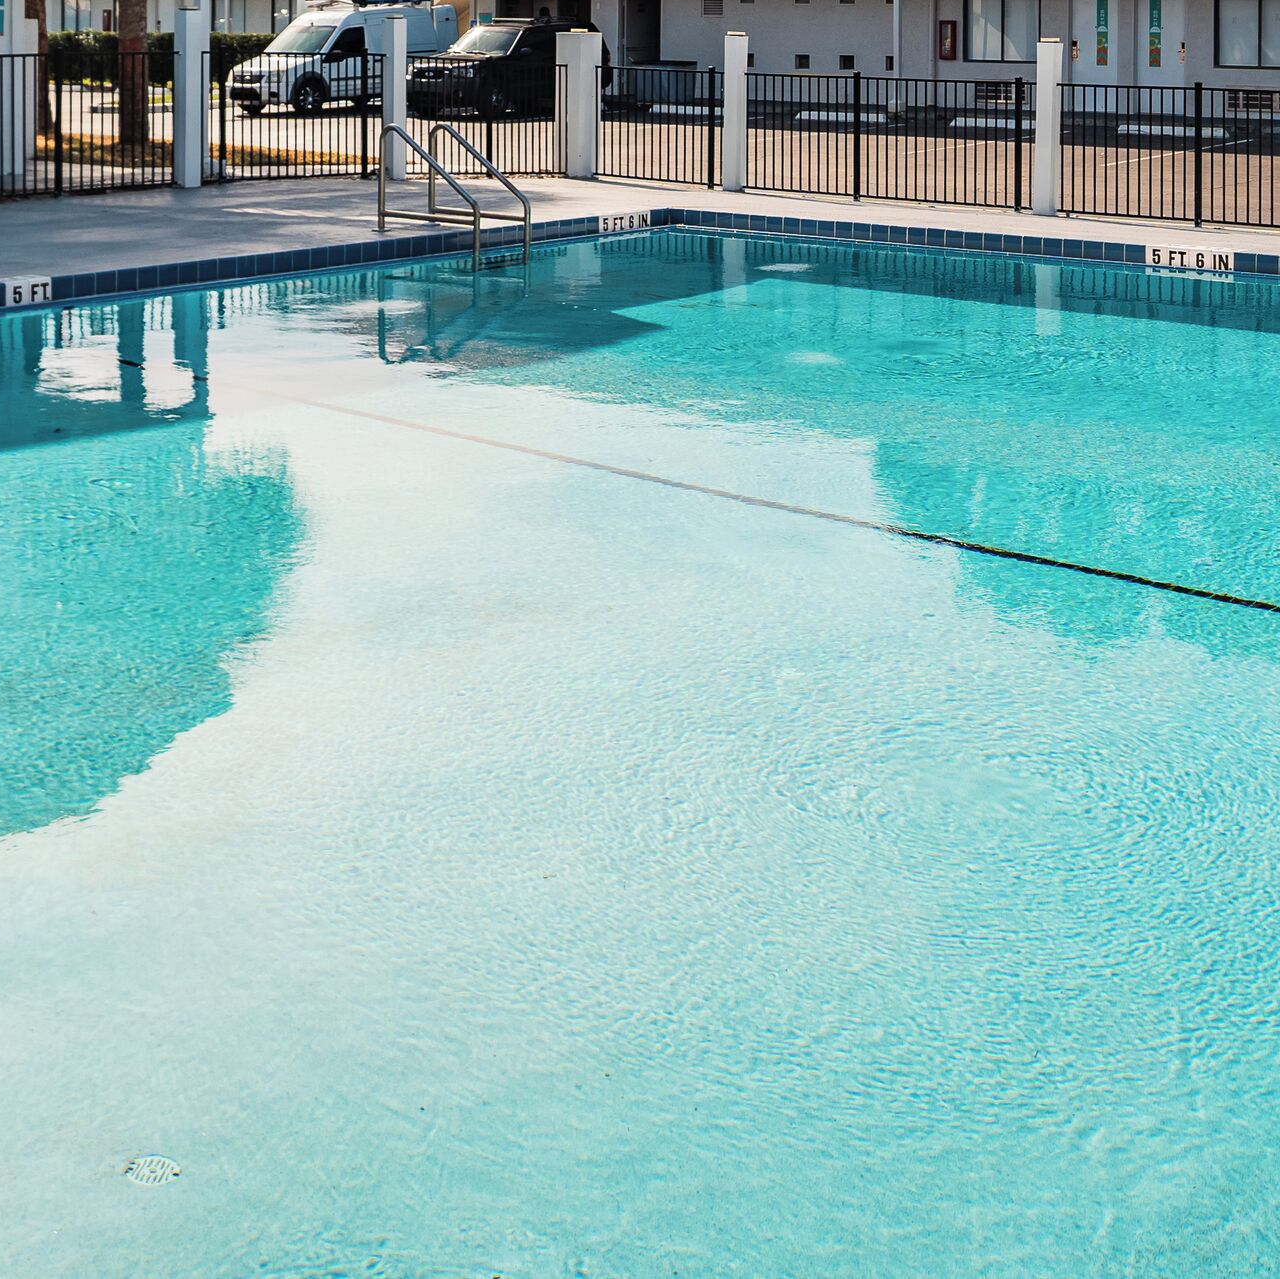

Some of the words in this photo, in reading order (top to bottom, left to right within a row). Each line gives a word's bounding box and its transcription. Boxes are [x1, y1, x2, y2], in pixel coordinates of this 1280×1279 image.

[603, 218, 609, 232] 5
[628, 215, 634, 229] 6
[1152, 249, 1161, 265] 5
[1168, 250, 1187, 267] FT.
[1195, 252, 1205, 268] 6
[1212, 253, 1233, 271] IN.
[12, 285, 23, 304] 5
